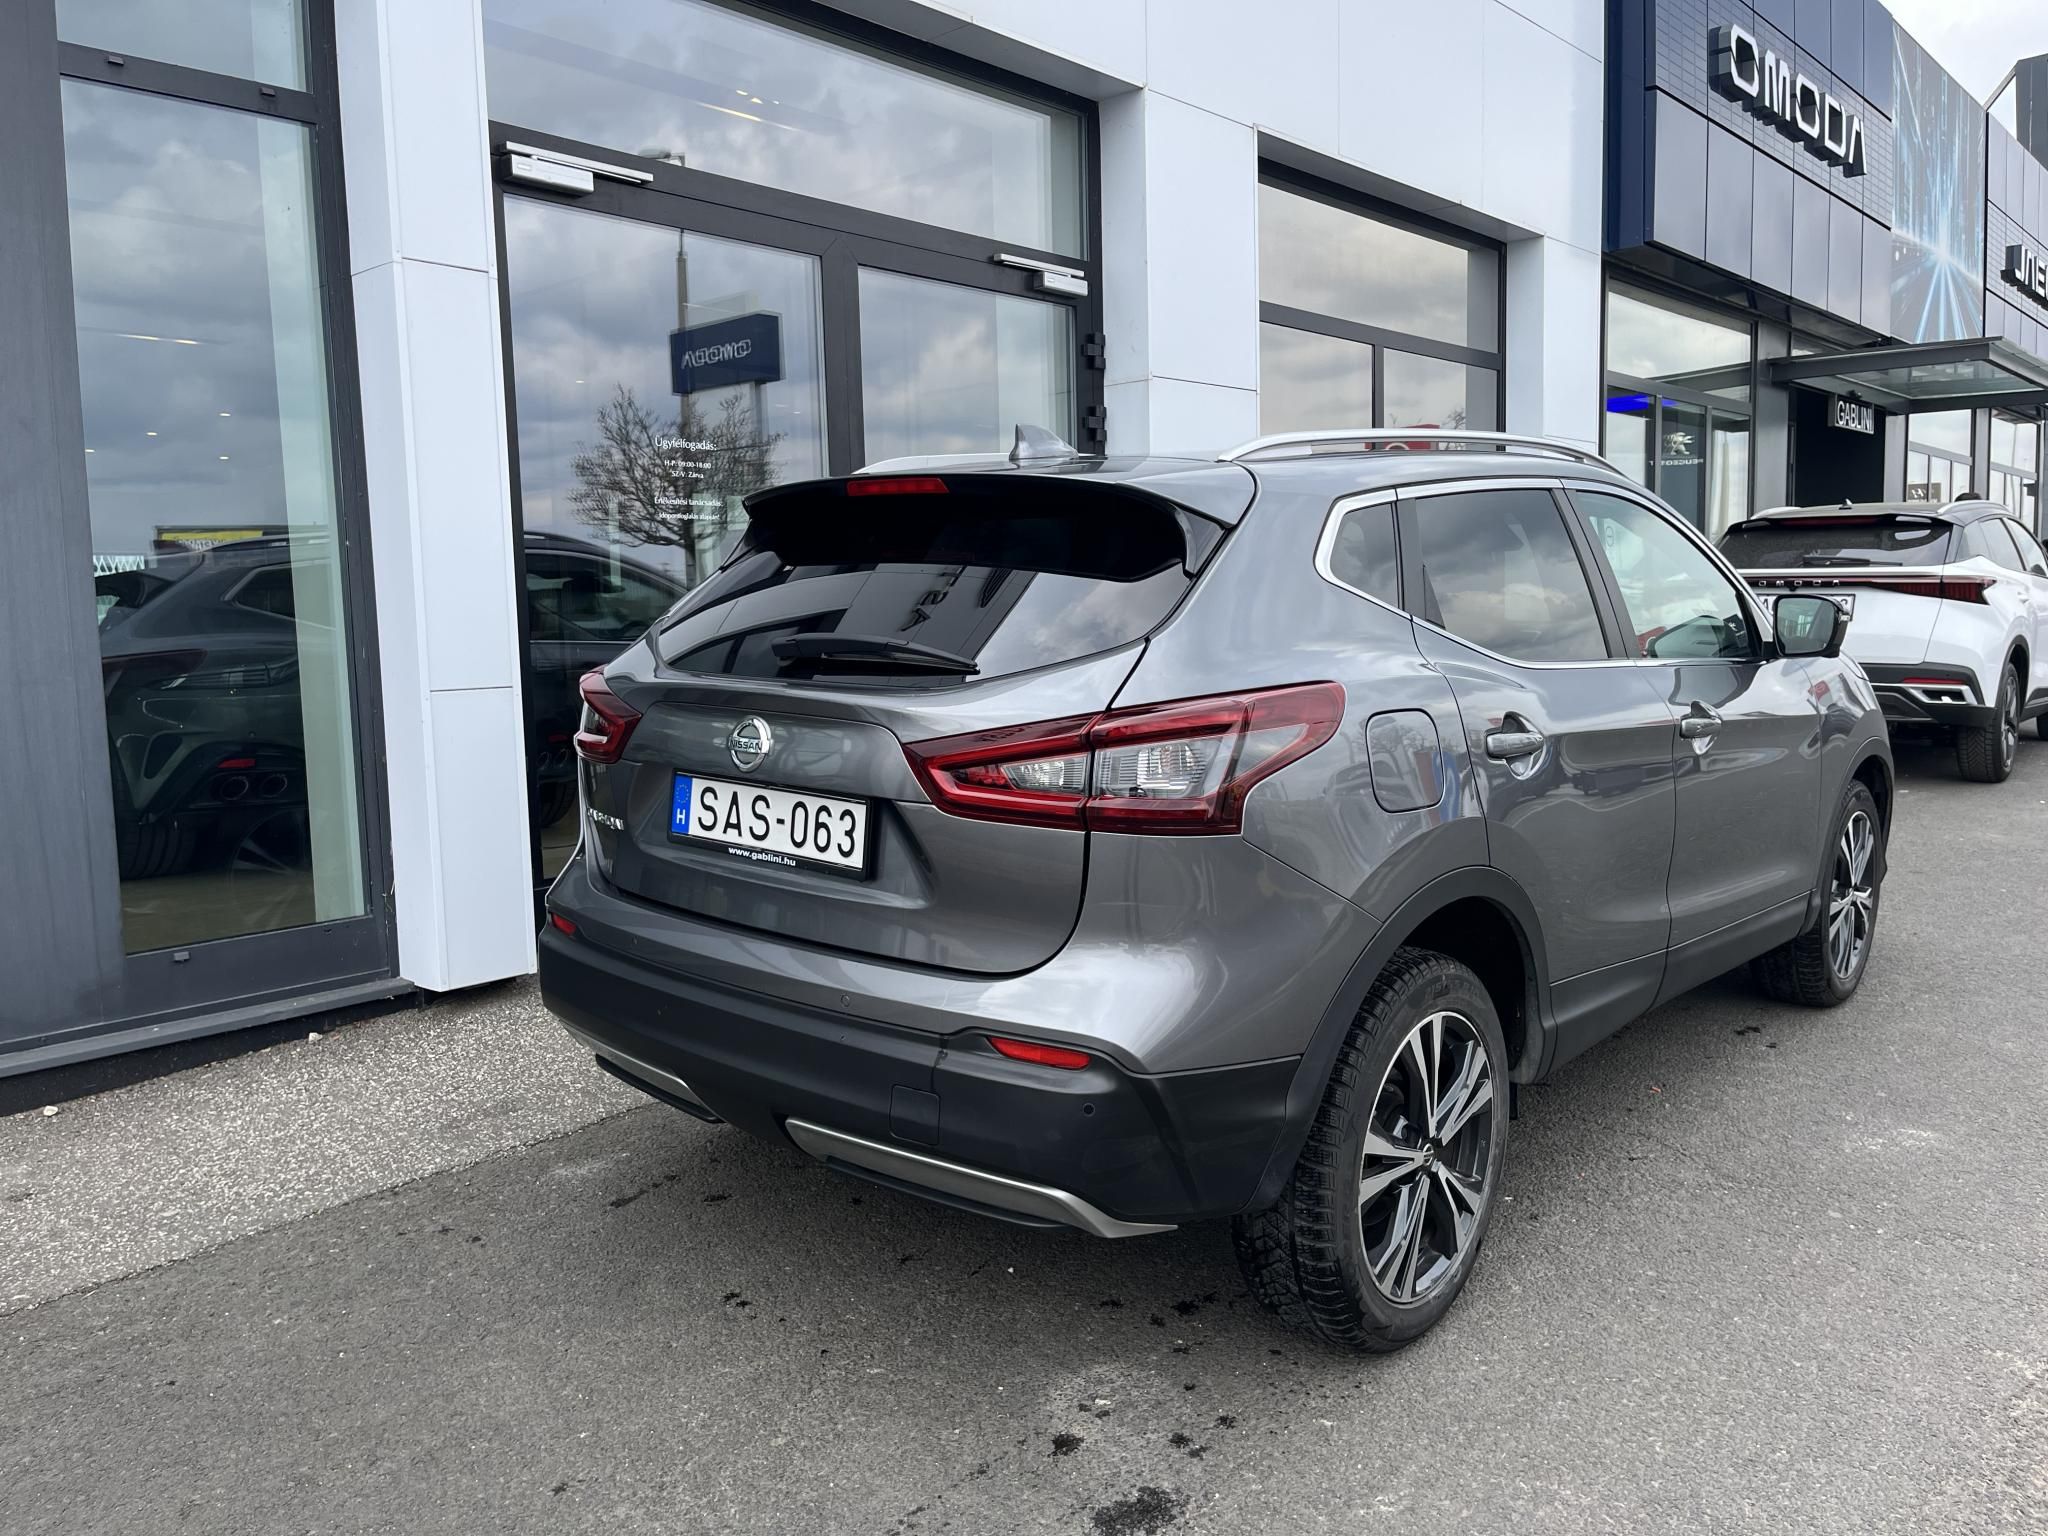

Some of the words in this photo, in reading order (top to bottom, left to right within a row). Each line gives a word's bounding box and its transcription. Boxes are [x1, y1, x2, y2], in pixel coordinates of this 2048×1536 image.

[1730, 23, 1867, 175] OMODA
[1837, 400, 1873, 432] GABLINI
[655, 435, 717, 451] Ügyfélfogadás:
[730, 739, 762, 751] NISSAN
[675, 808, 687, 825] H
[697, 786, 857, 858] SAS-063
[728, 846, 797, 867] www.gablini.hu
